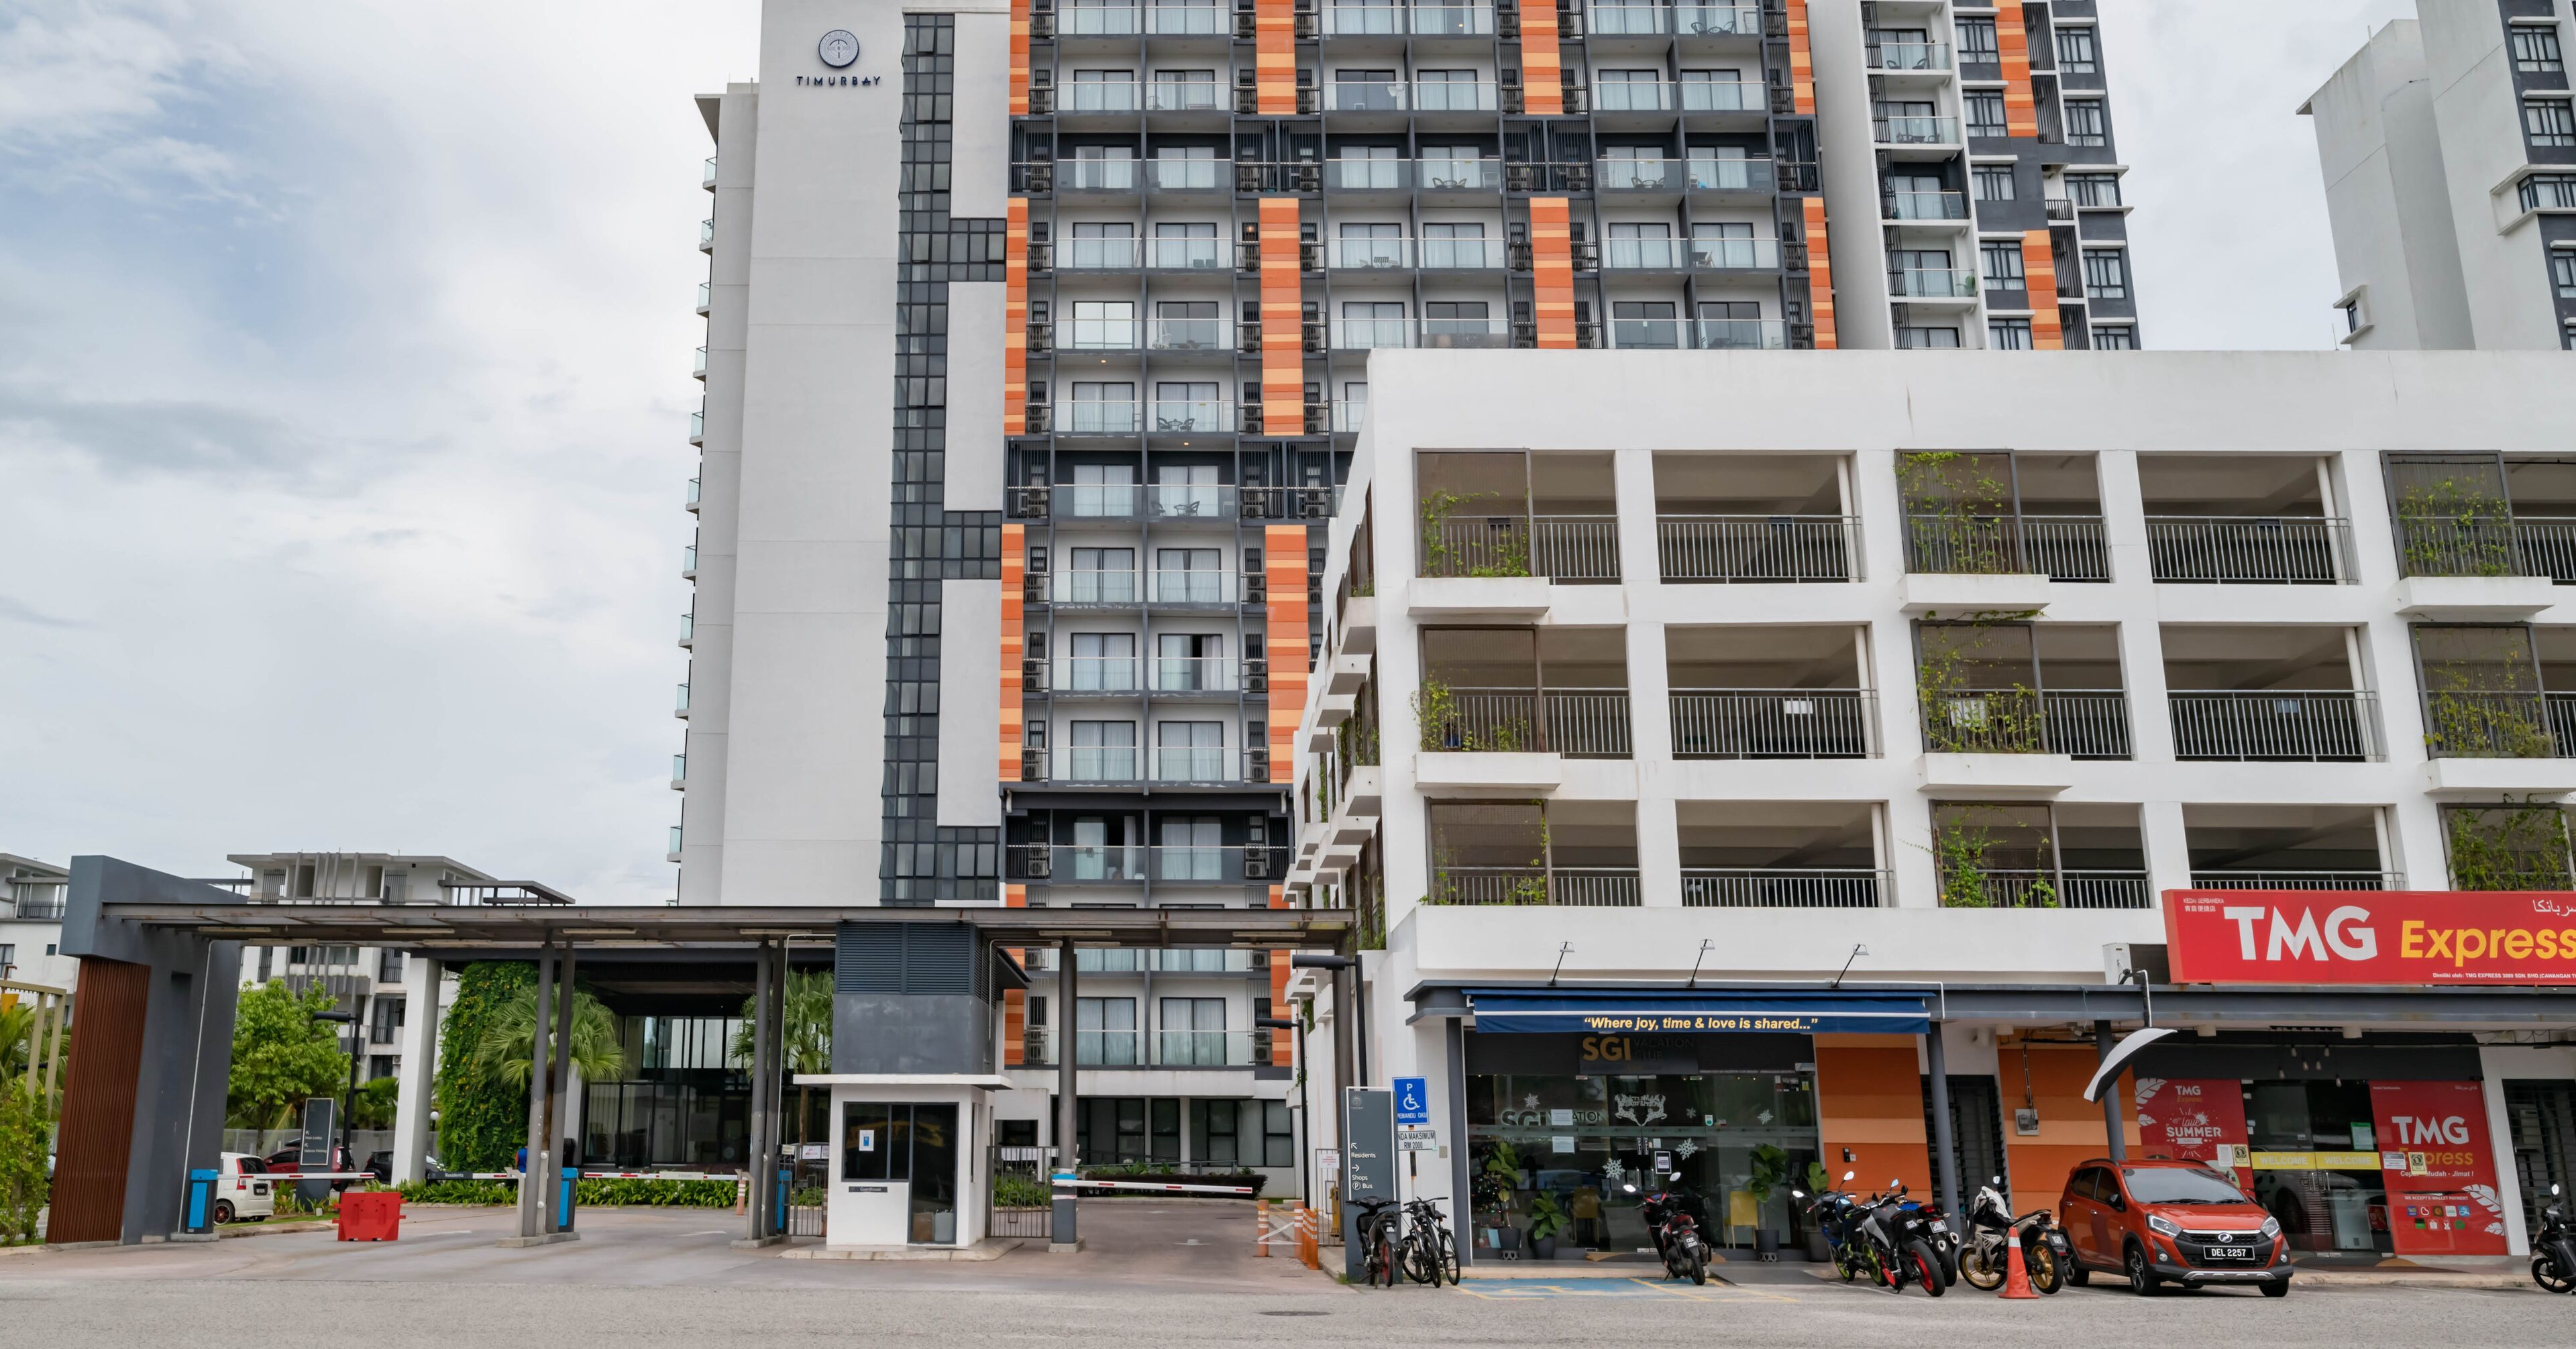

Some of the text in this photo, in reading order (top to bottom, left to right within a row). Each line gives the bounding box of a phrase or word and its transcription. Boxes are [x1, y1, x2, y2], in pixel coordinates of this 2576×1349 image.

[796, 76, 881, 86] TIMURBAY
[2223, 906, 2576, 967] TMG Express
[1634, 1017, 1659, 1031] joy,
[1663, 1017, 1691, 1028] time
[1695, 1017, 1705, 1028] &
[1708, 1017, 1736, 1028] love
[1739, 1017, 1751, 1028] is
[1582, 1036, 1695, 1062] SGI VACATION
[1634, 1050, 1663, 1061] CLUB
[1406, 1083, 1413, 1091] P
[2176, 1085, 2201, 1095] TMG
[2167, 1127, 2222, 1137] SUMMER
[2392, 1116, 2469, 1144] TMG
[1408, 1132, 1434, 1140] MAKSIMUM
[2260, 1156, 2308, 1165] WELCOME
[2324, 1156, 2372, 1165] WELCOME
[2211, 1248, 2246, 1256] DEL 2257
